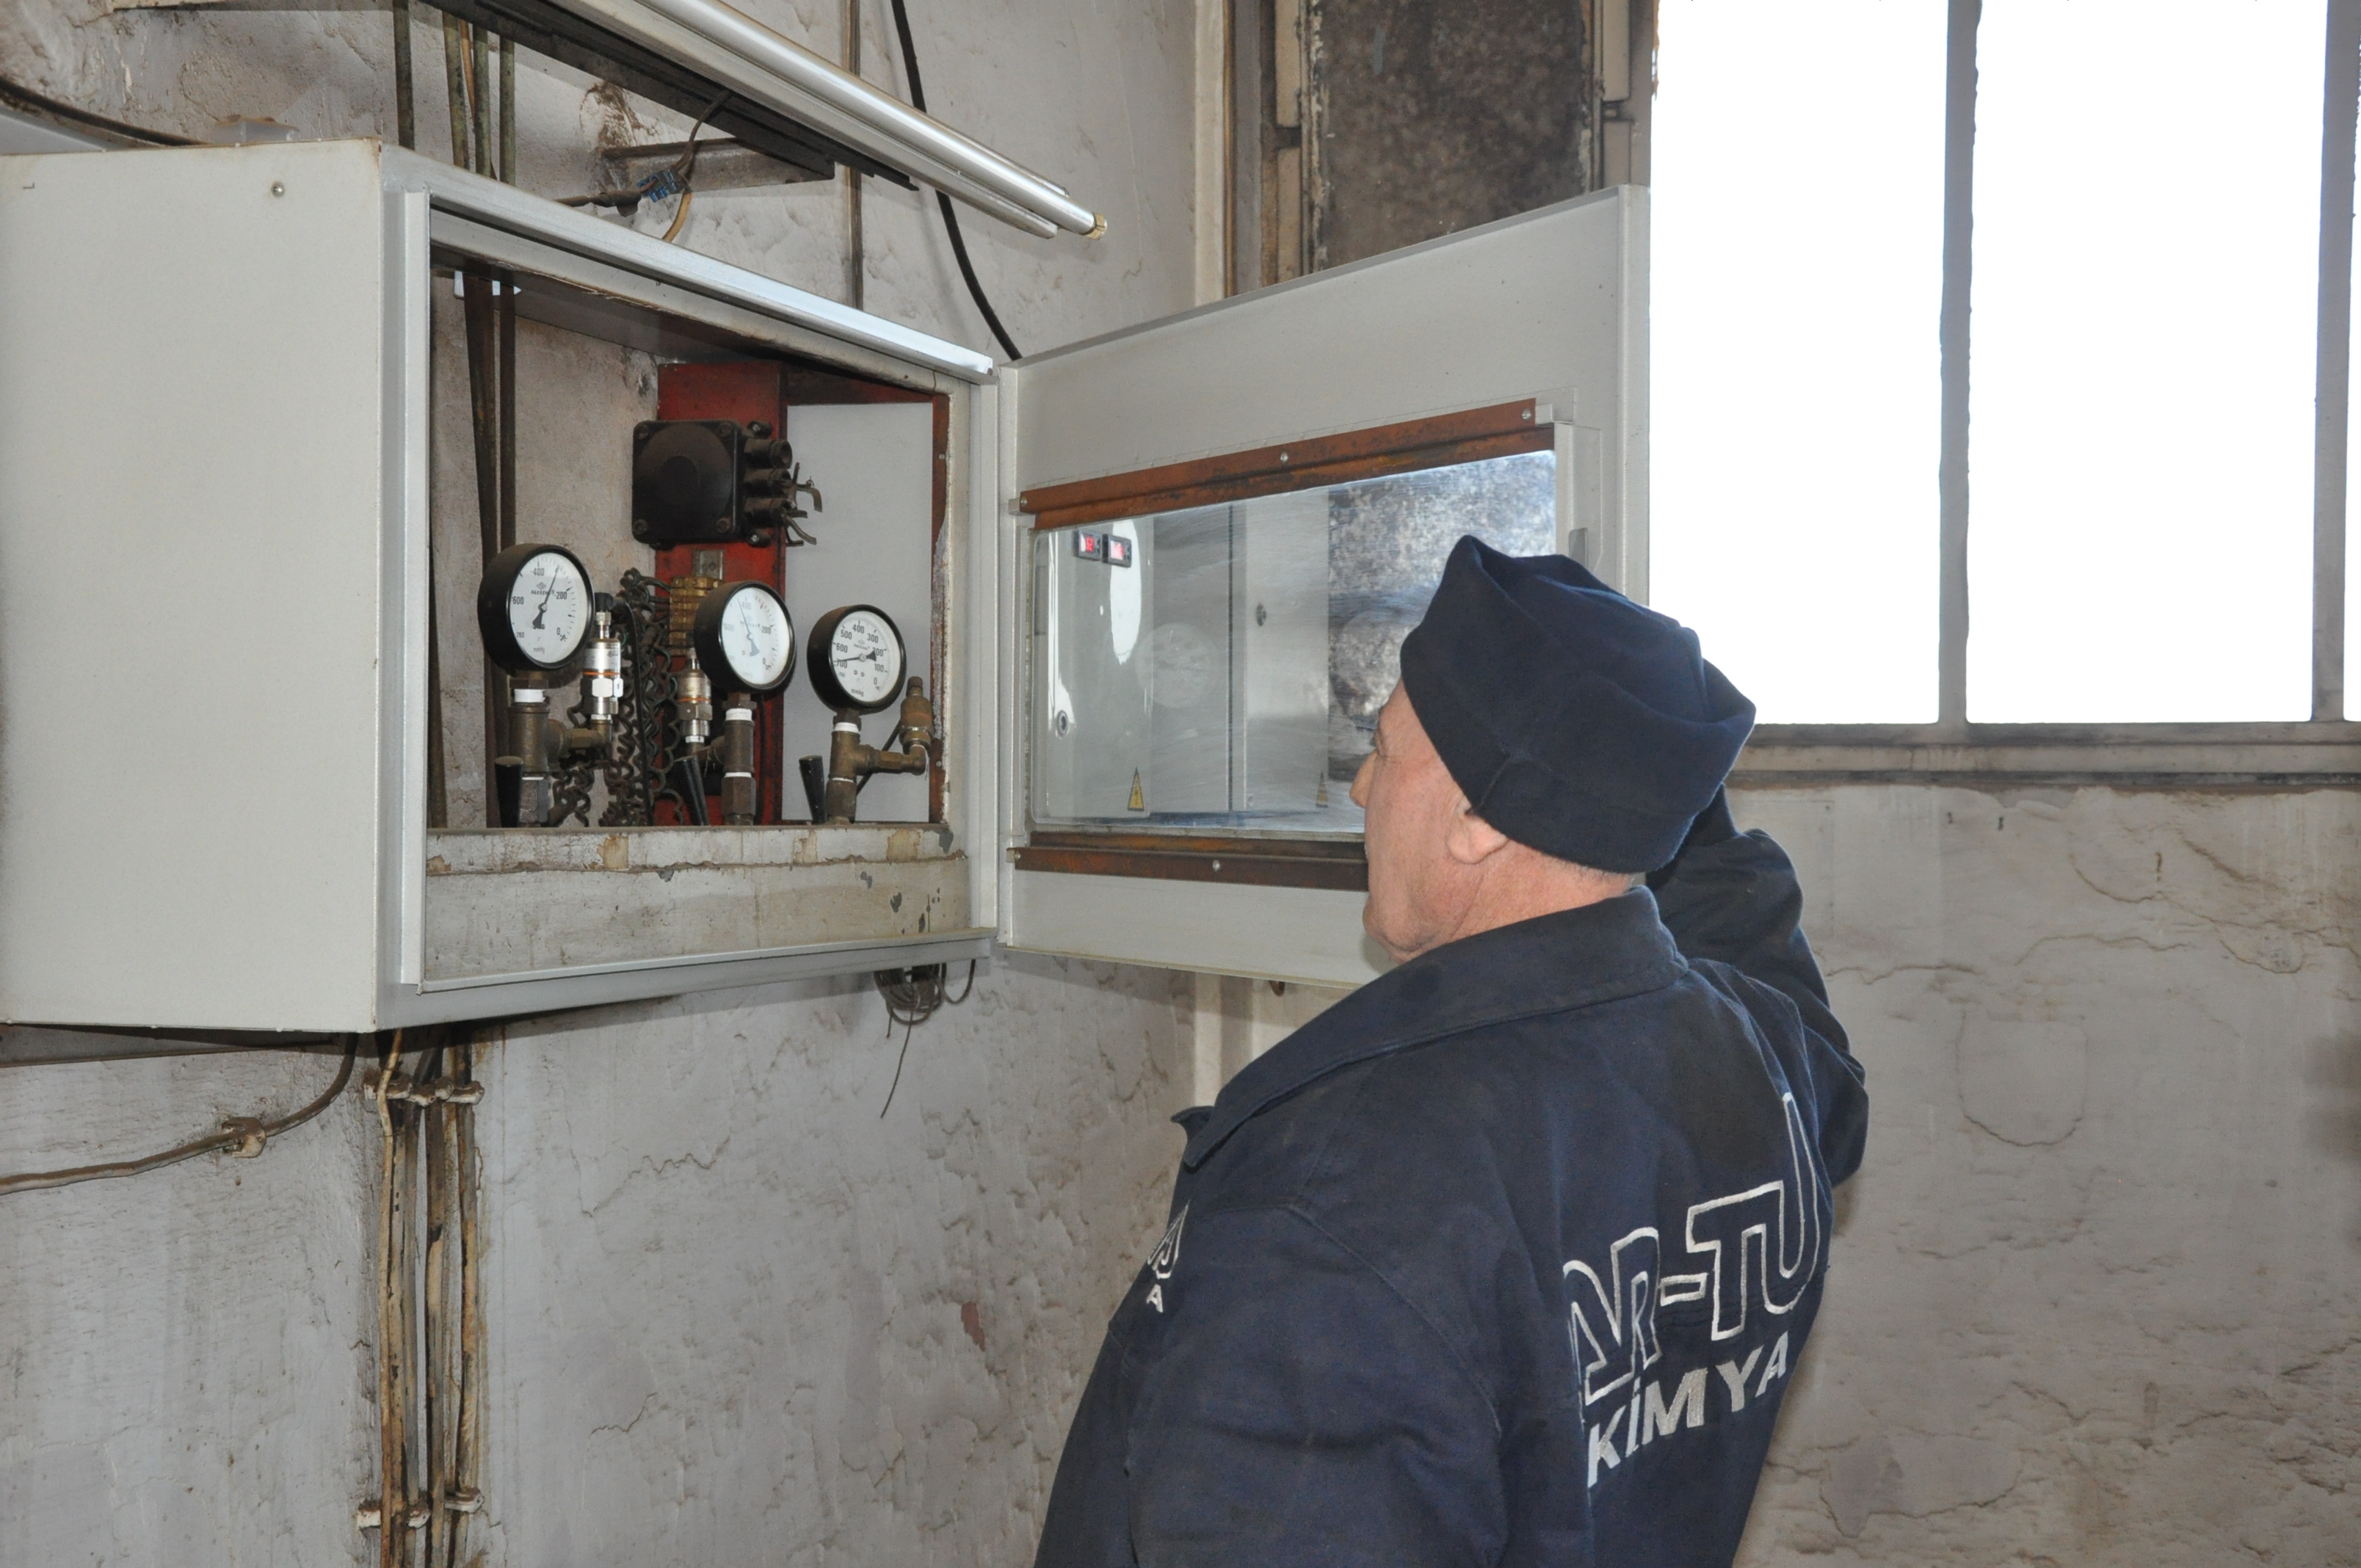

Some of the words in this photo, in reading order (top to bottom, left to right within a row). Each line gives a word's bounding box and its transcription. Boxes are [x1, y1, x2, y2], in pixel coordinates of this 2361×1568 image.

[556, 628, 561, 636] 0
[852, 624, 865, 634] 400
[841, 630, 852, 639] 500
[867, 634, 879, 643] 300
[836, 644, 848, 653] 600
[874, 663, 885, 672] 100
[873, 677, 877, 685] 0
